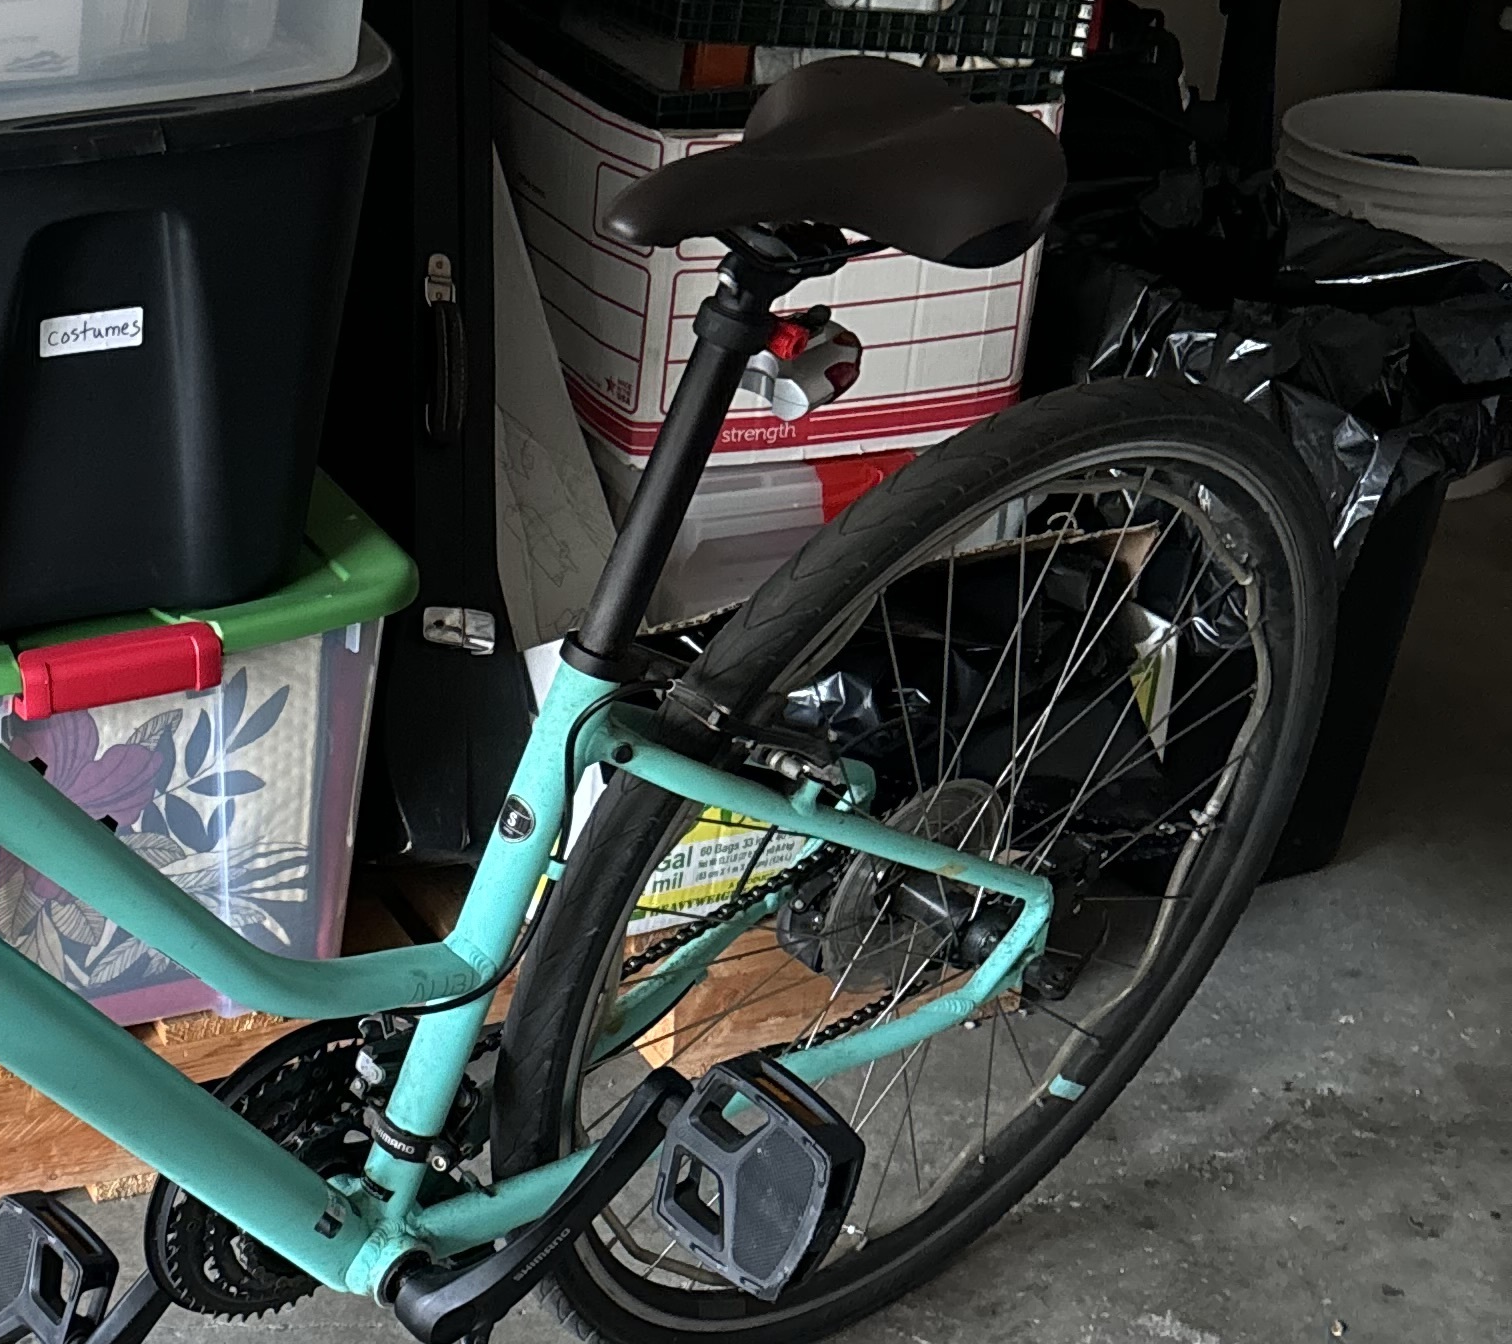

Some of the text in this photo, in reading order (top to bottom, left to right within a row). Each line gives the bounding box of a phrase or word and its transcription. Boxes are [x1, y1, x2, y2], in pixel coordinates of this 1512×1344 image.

[721, 422, 797, 444] strength
[700, 846, 712, 857] 60
[714, 842, 740, 856] Bags
[652, 872, 683, 894] mil
